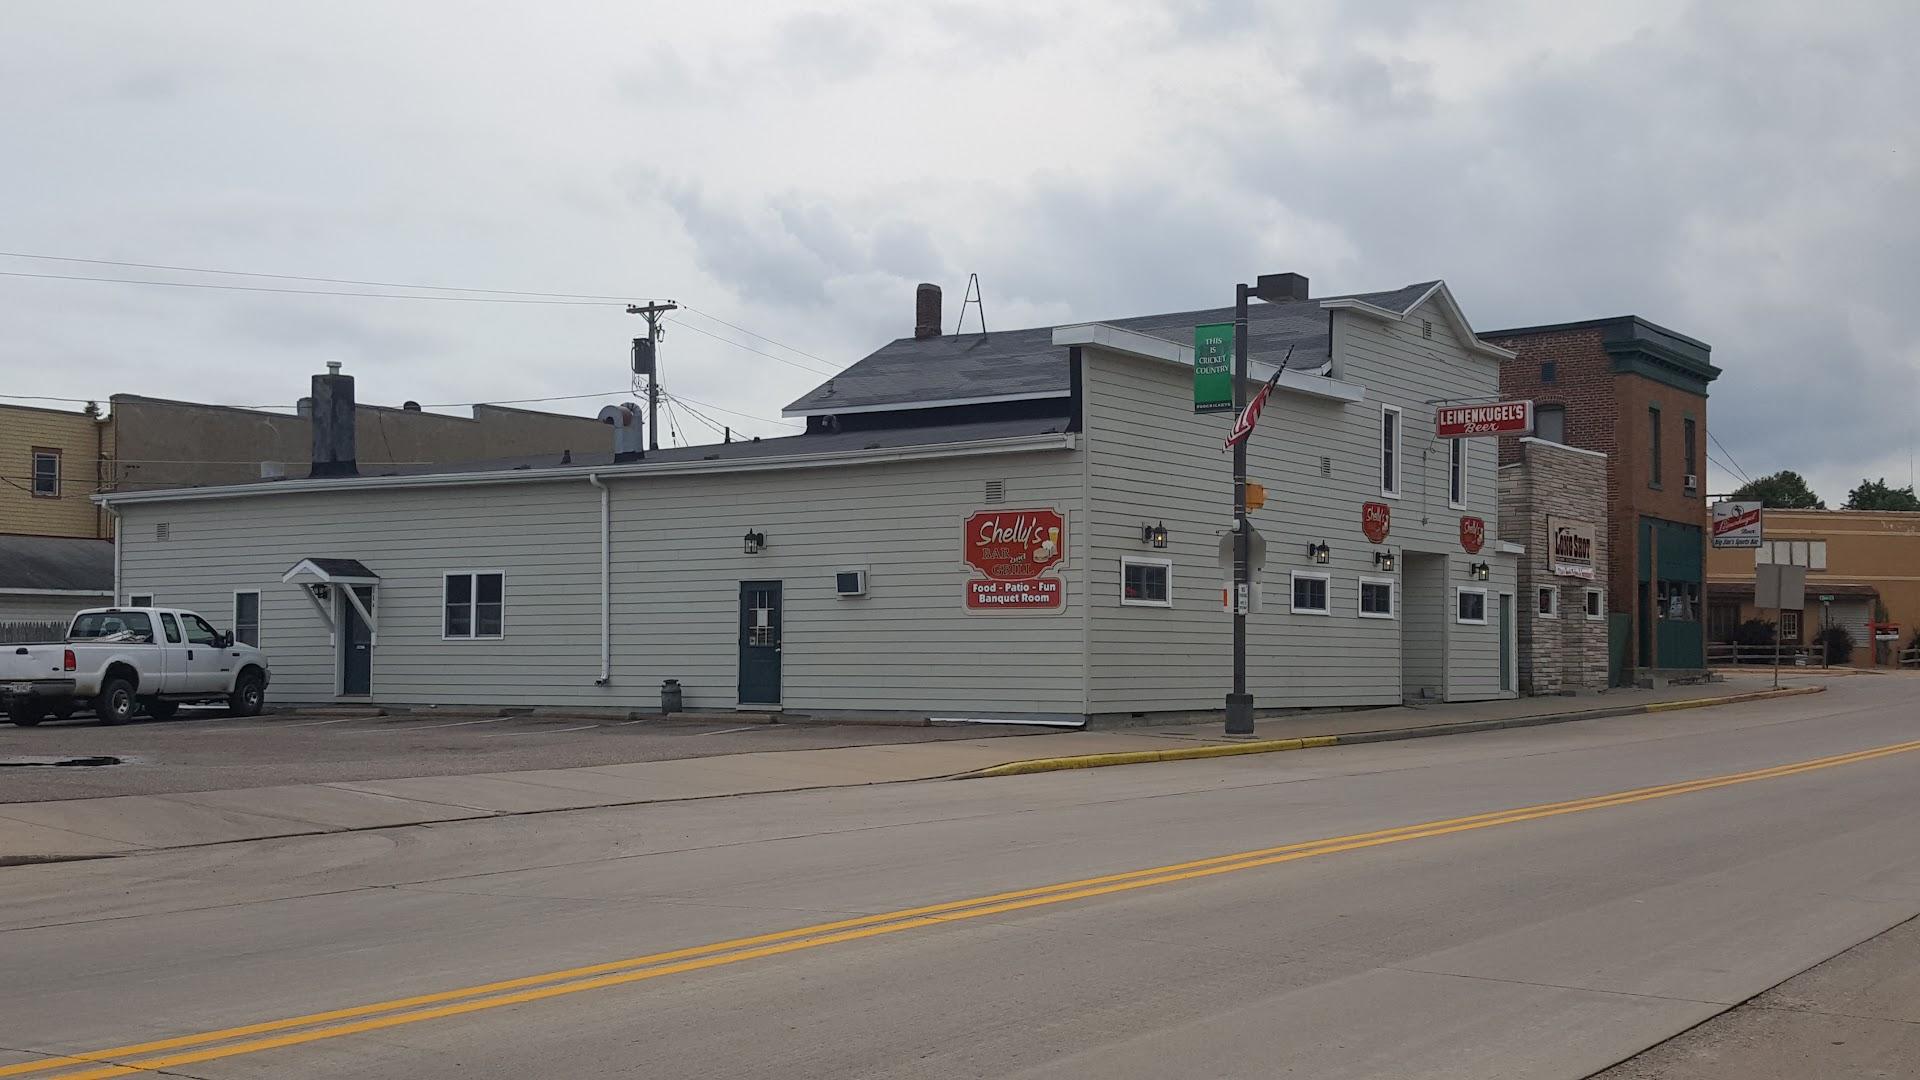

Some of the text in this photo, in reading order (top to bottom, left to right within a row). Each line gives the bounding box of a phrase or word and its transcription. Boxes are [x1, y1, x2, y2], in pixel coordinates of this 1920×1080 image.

[1206, 337, 1222, 345] THIS
[1199, 355, 1227, 364] CRICKET
[1196, 365, 1229, 374] COUNTRY
[1440, 405, 1524, 426] LEINENKUGEL'S
[1464, 422, 1499, 433] Beer
[976, 515, 1044, 550] Shelly's
[1556, 532, 1590, 558] LONG SHOT
[982, 547, 1010, 560] BAR
[992, 563, 1035, 576] GRILL
[973, 583, 996, 592] Food
[1005, 582, 1030, 592] Patio
[1038, 582, 1056, 592] Fun
[979, 593, 1050, 605] Banquet Room
